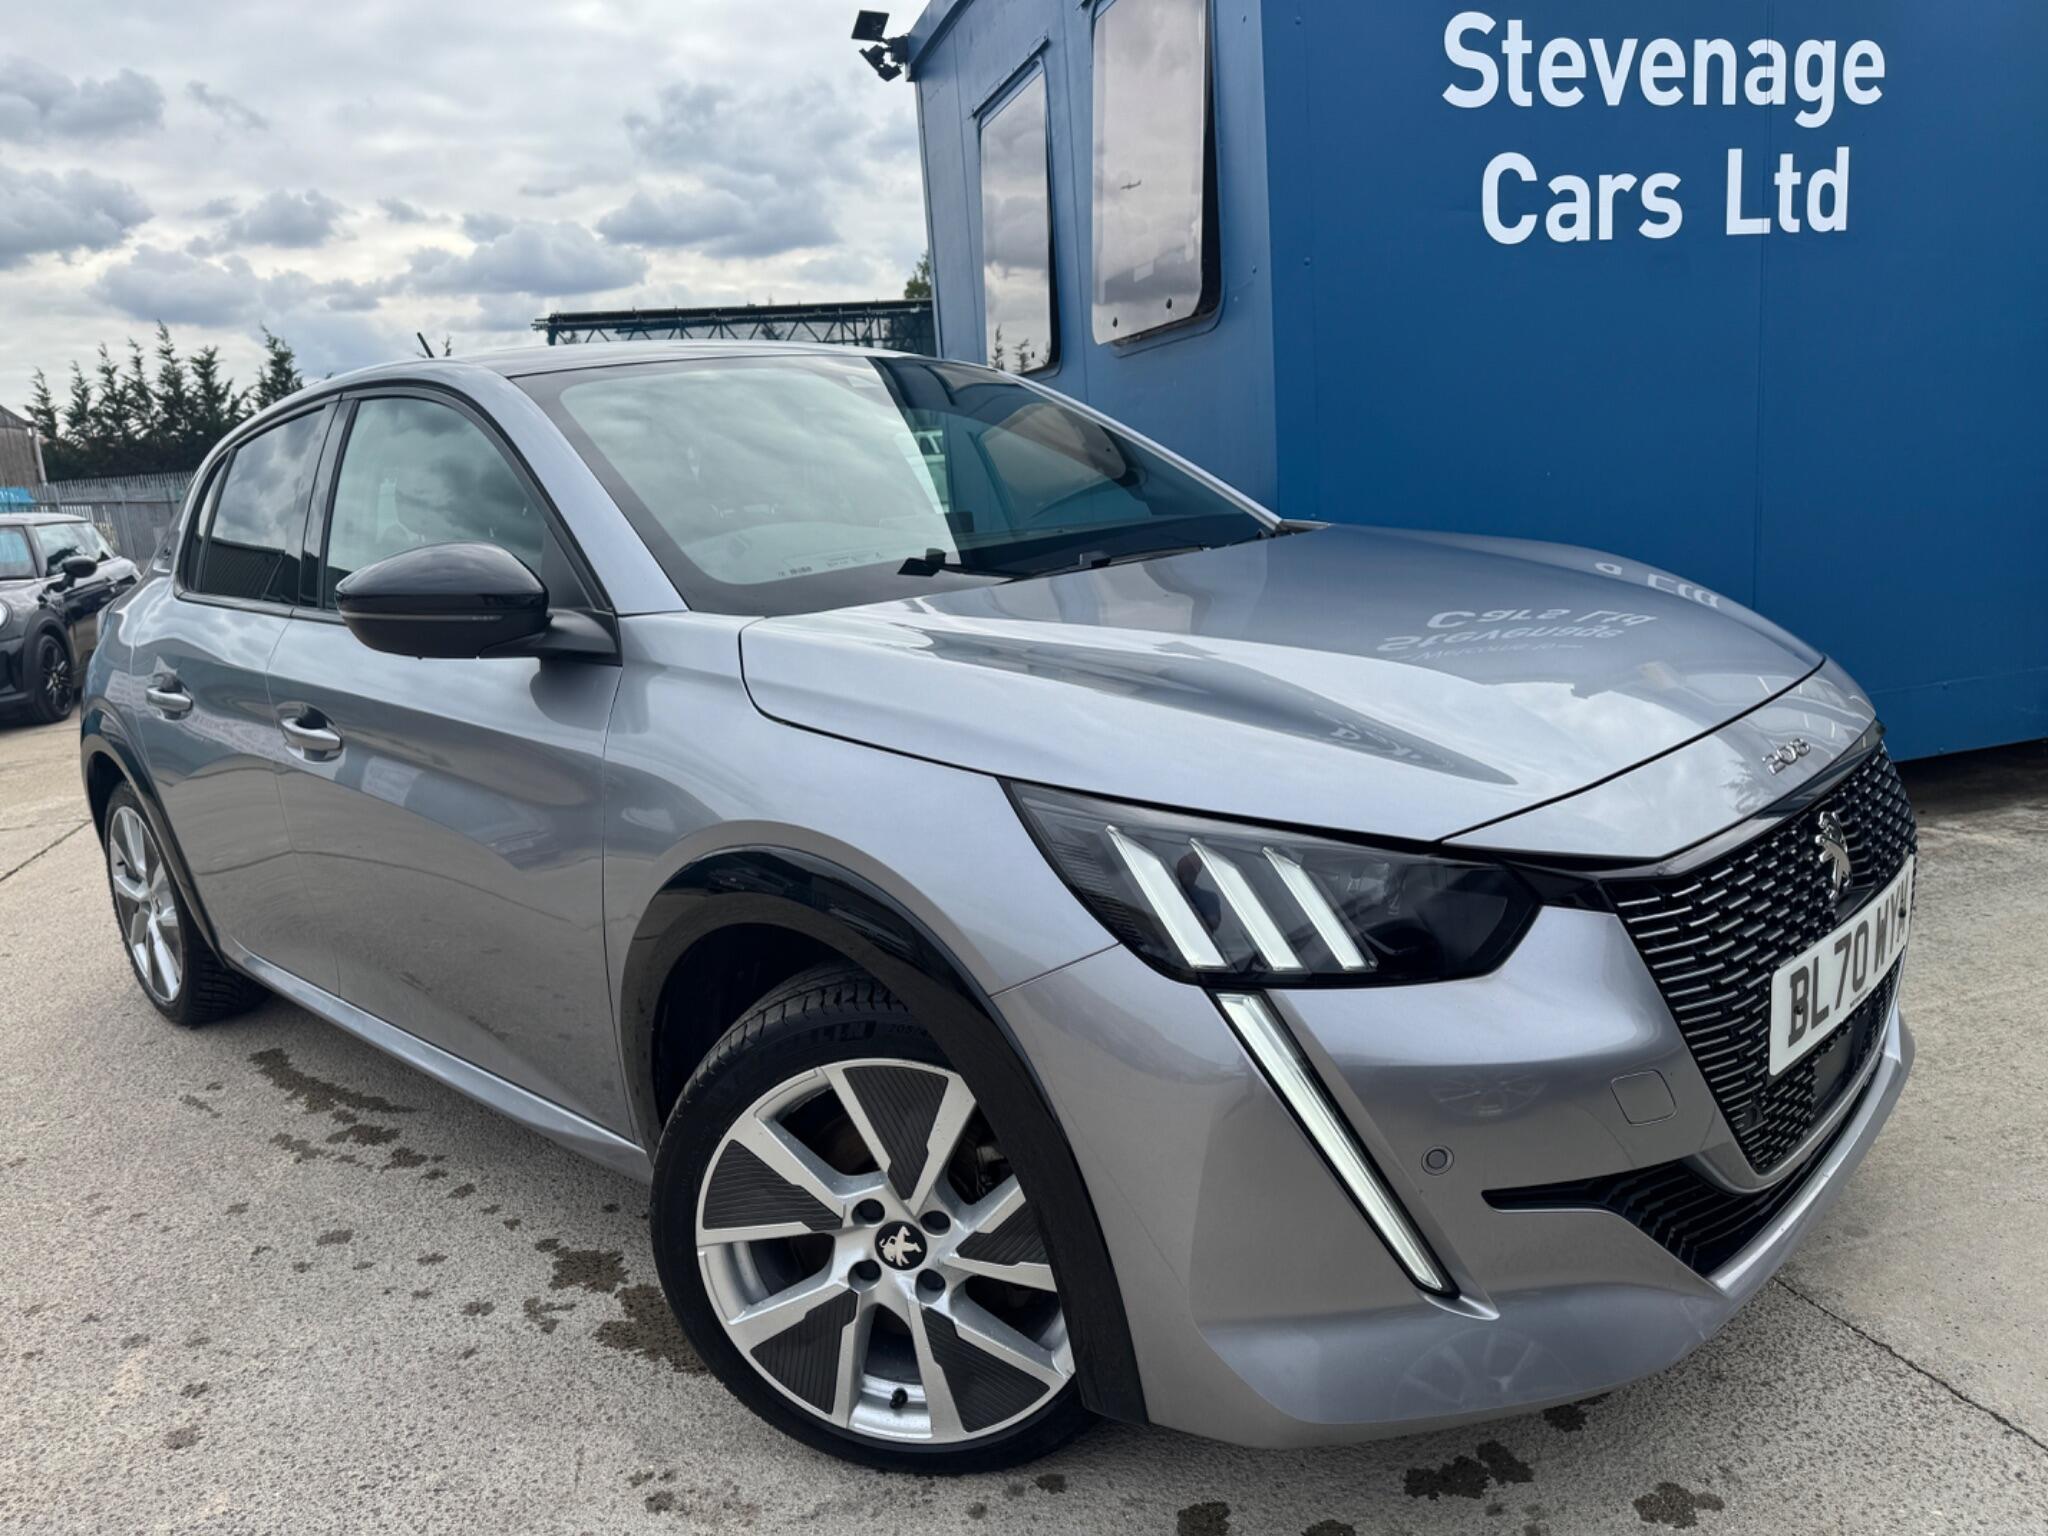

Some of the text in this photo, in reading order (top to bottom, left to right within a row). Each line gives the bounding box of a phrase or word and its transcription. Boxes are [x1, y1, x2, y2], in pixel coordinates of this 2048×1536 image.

[1442, 11, 1885, 128] Stevenage
[1482, 146, 1849, 244] Cars Ltd
[1761, 738, 1810, 776] 208
[1788, 919, 1870, 1048] BL70
